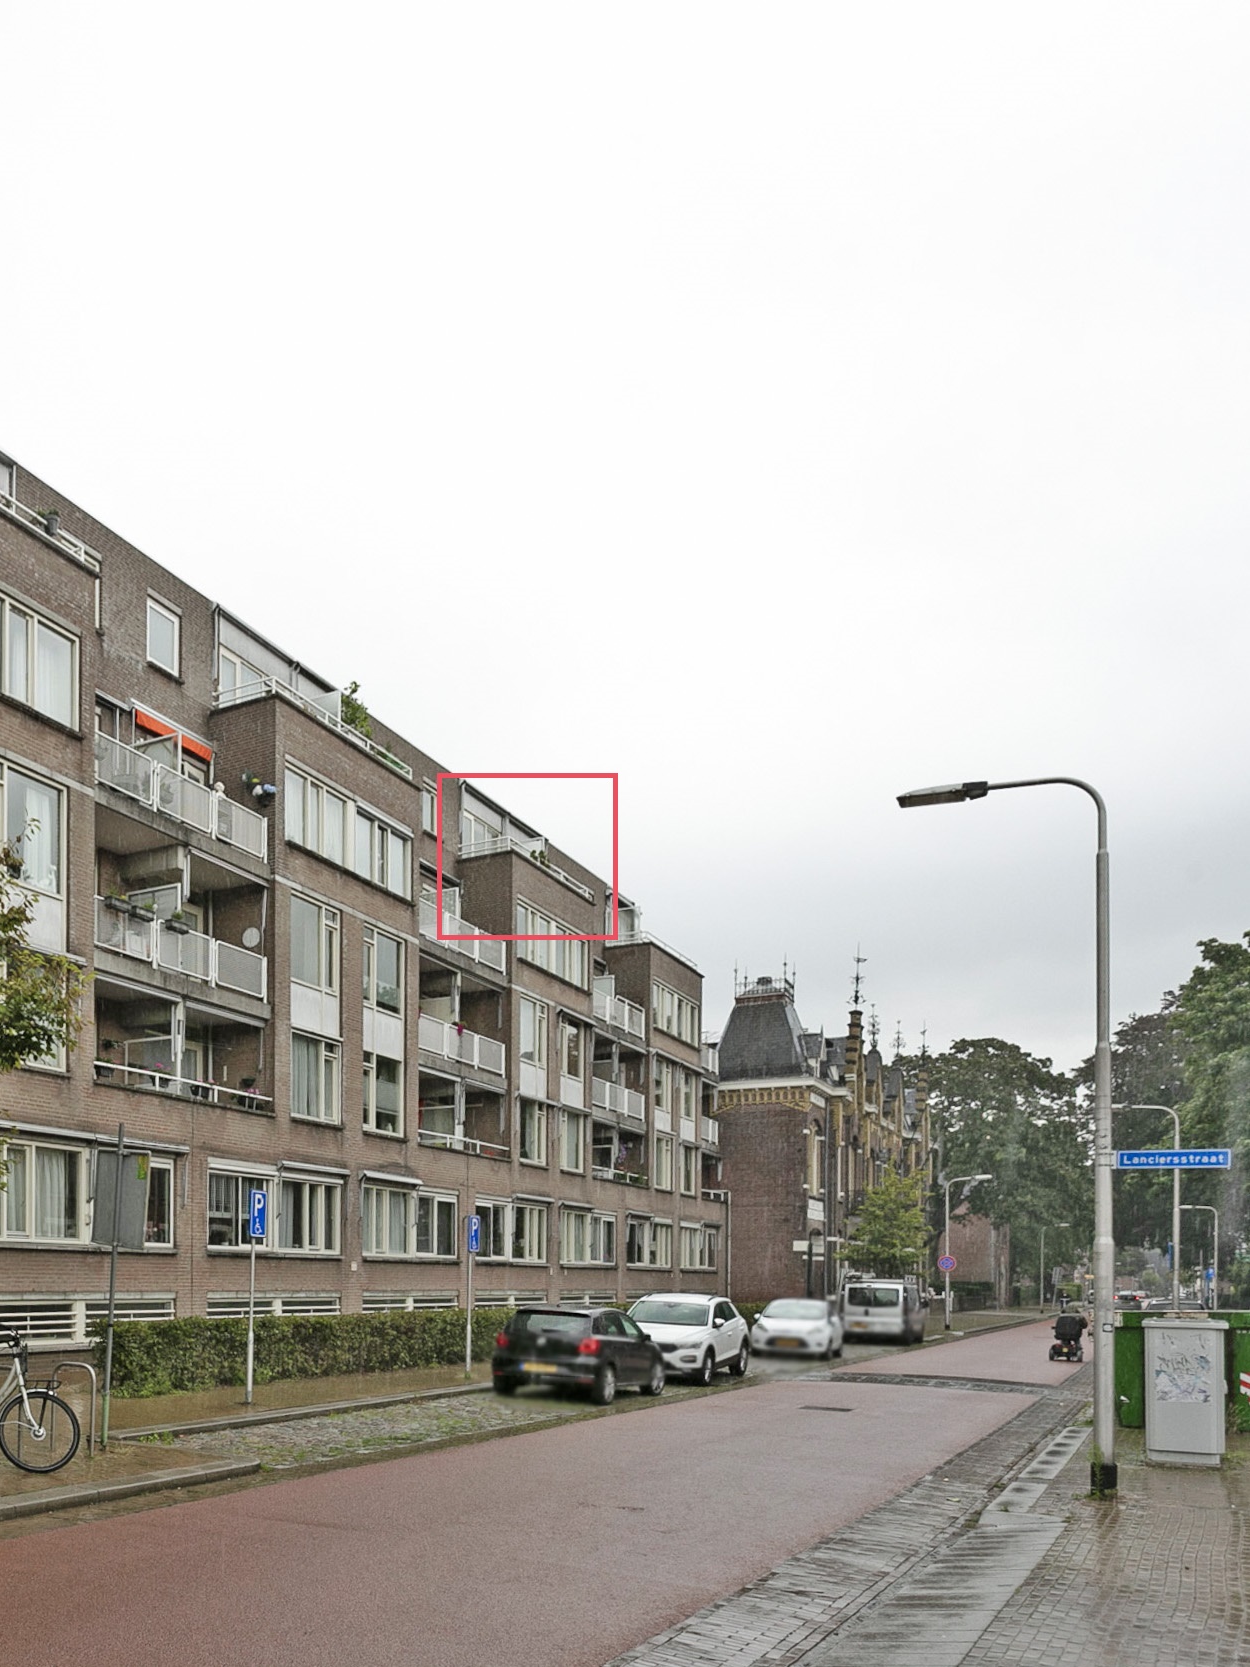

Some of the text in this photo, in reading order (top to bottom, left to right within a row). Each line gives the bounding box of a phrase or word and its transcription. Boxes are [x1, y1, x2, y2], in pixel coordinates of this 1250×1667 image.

[1123, 1154, 1224, 1164] Lanciersstraat
[254, 1194, 264, 1217] P
[471, 1218, 478, 1236] P
